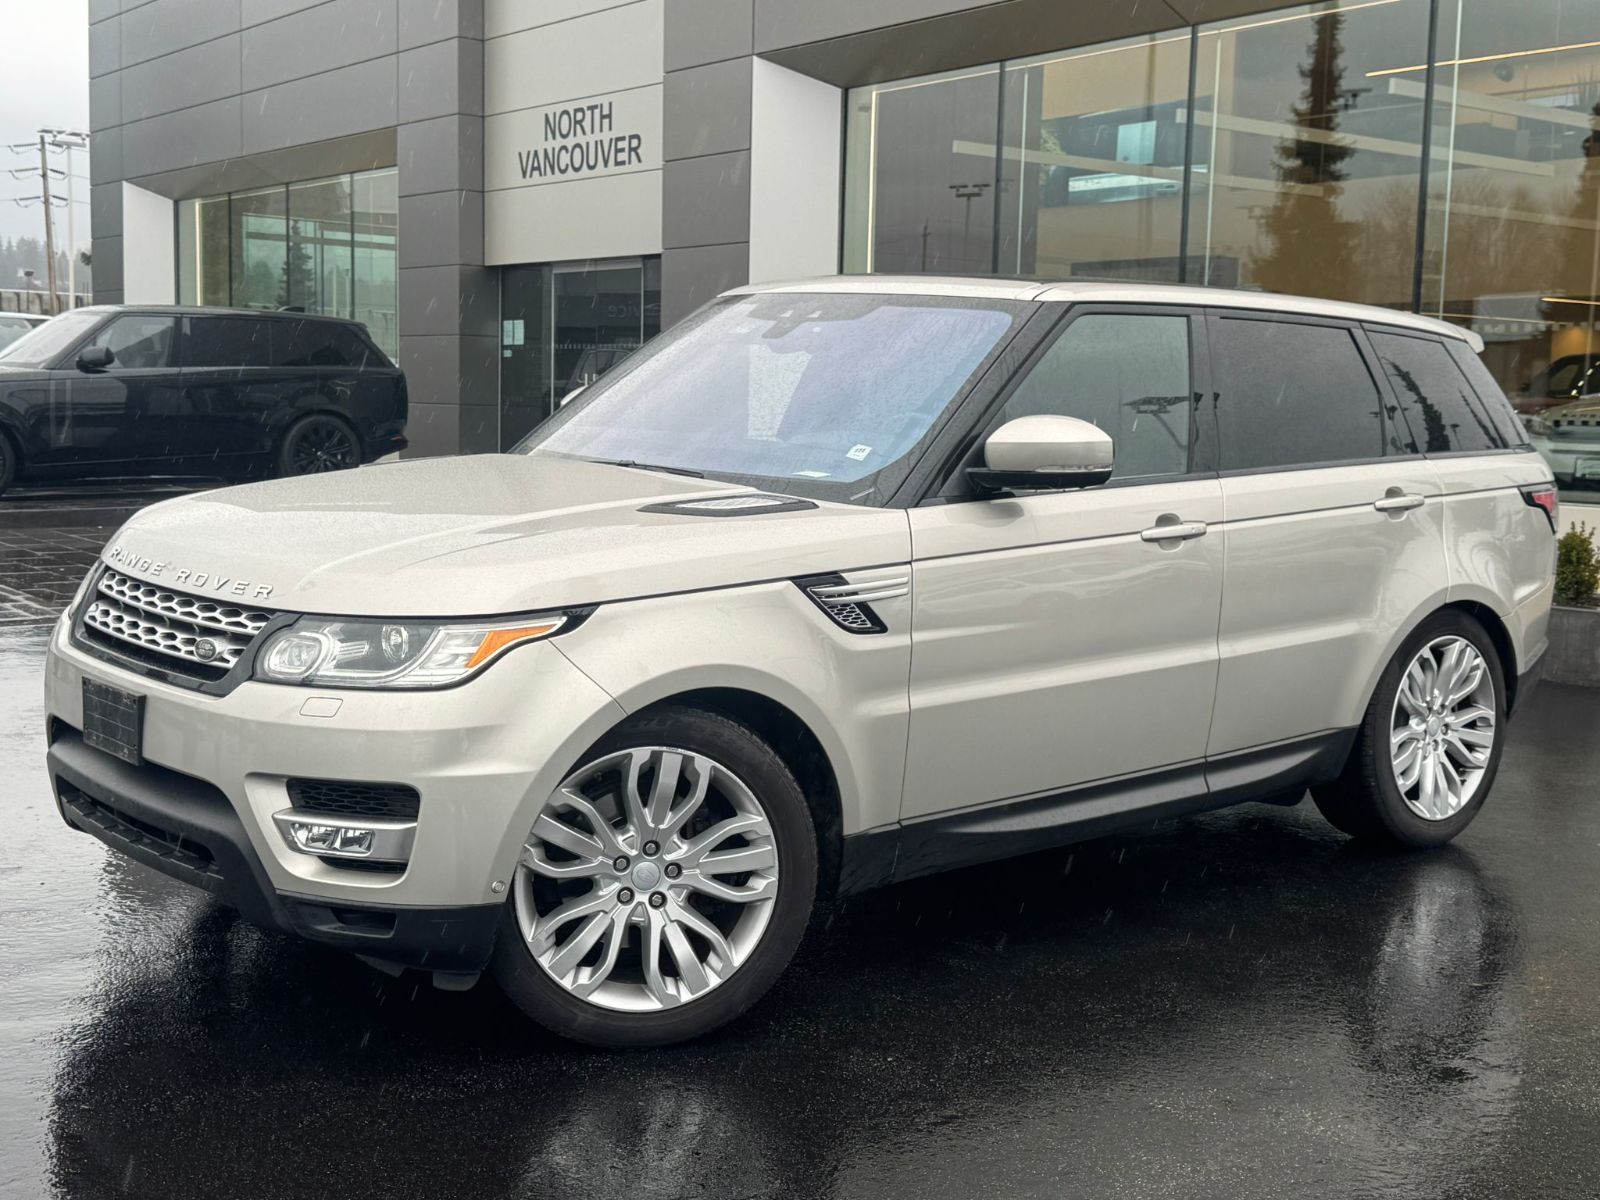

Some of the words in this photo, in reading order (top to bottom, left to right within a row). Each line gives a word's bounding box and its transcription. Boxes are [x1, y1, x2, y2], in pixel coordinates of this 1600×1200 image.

[544, 101, 613, 142] NORTH
[518, 133, 643, 179] VANCOUVER
[110, 546, 166, 576] RANGE
[175, 568, 273, 598] ROVER
